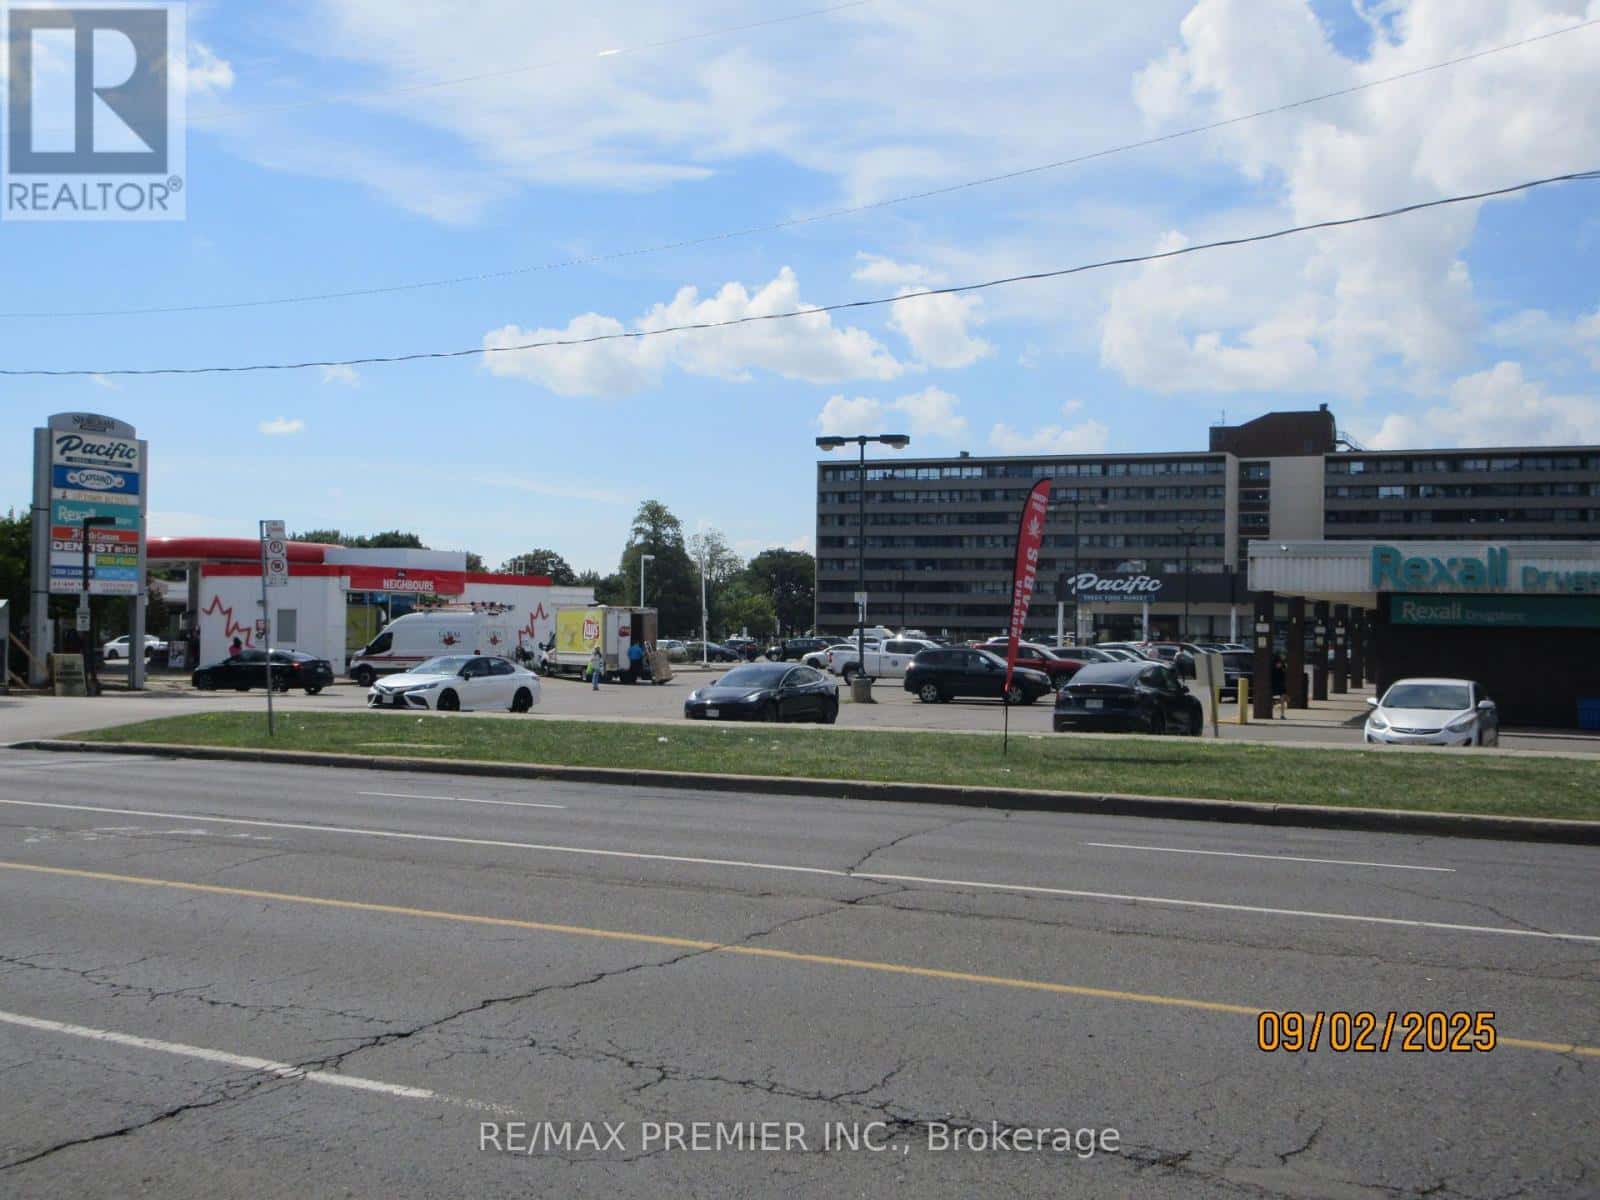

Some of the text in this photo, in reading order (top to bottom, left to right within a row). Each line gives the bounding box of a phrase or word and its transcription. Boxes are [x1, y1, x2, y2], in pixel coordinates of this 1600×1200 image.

[56, 434, 137, 460] Pacific
[53, 541, 114, 553] DENIST
[1371, 543, 1510, 590] Rexall
[383, 579, 434, 591] NEIGHBOURS
[1067, 572, 1163, 595] Pacific
[1401, 600, 1462, 621] Rexall
